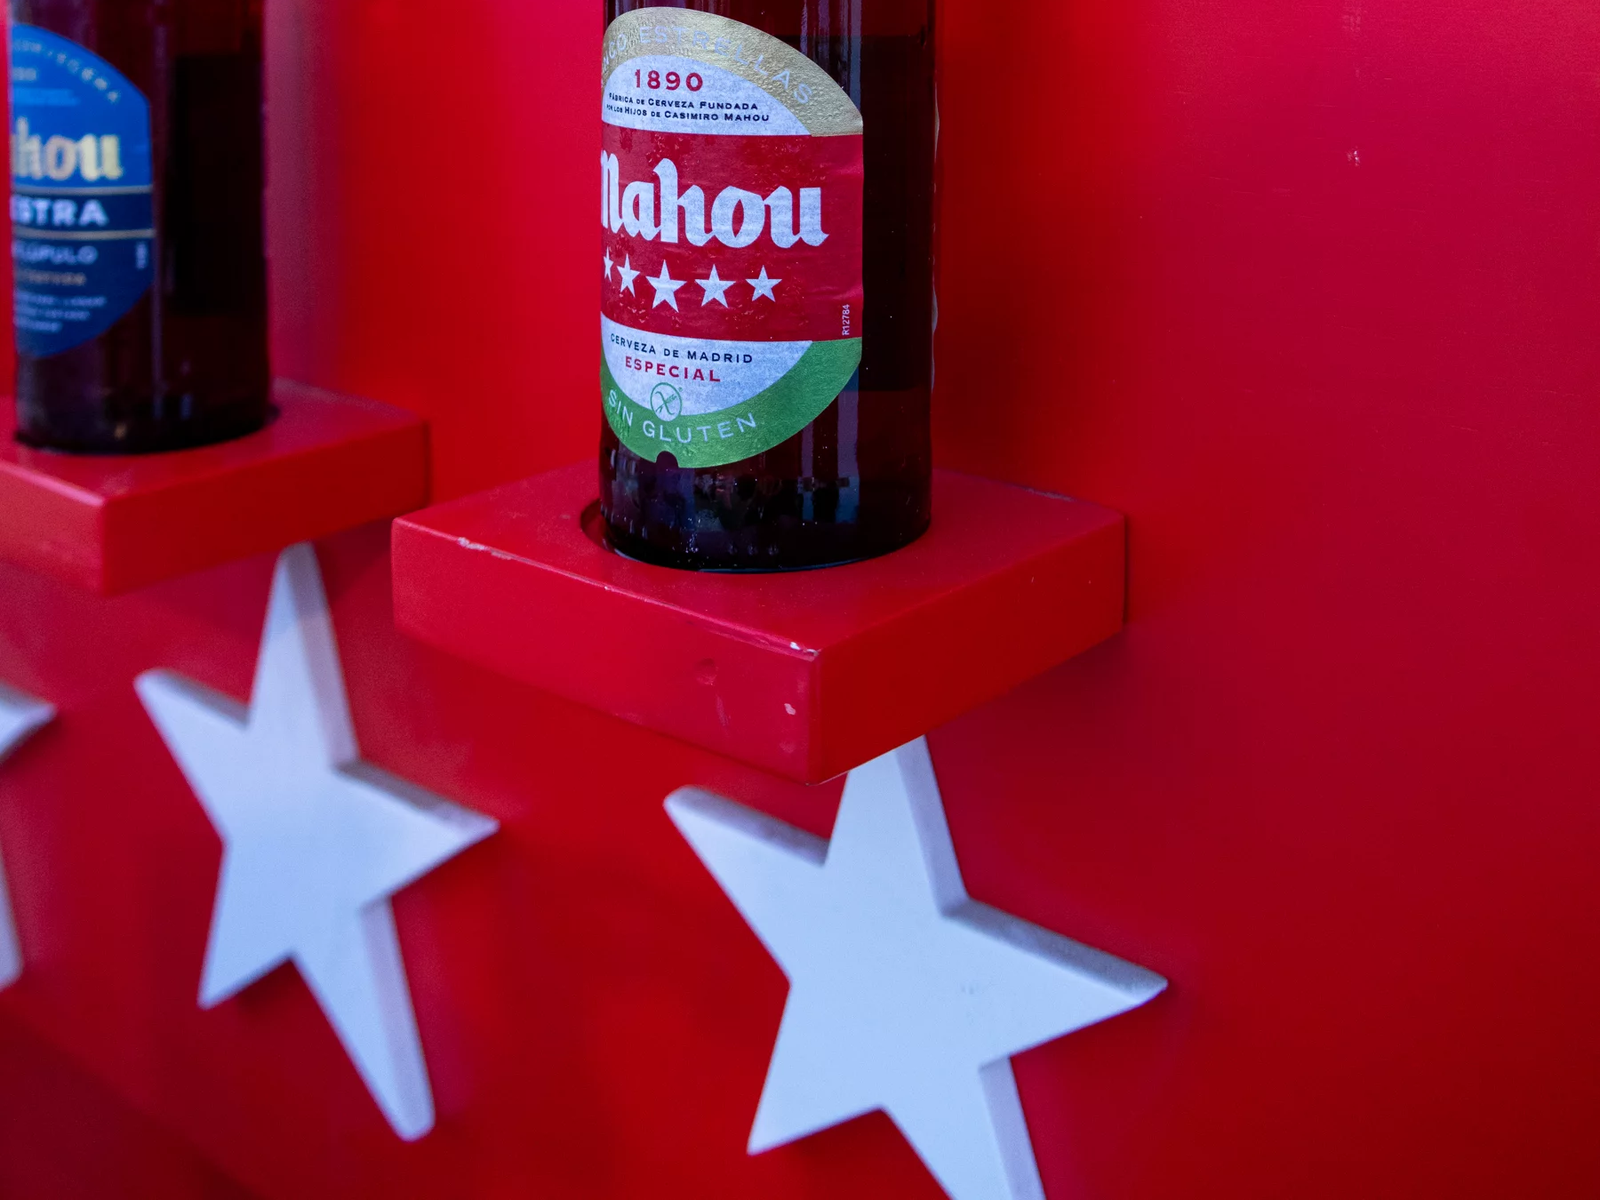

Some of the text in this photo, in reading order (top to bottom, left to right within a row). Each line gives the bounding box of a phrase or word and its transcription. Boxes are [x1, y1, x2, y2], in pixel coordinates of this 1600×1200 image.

[635, 68, 704, 92] 1890
[639, 26, 813, 104] ESTRELLAS
[841, 303, 851, 336] R12784
[610, 333, 753, 364] CERVEZA DE MADRID
[625, 355, 721, 382] ESPECIAL
[608, 389, 757, 443] SIN GLUTEN
